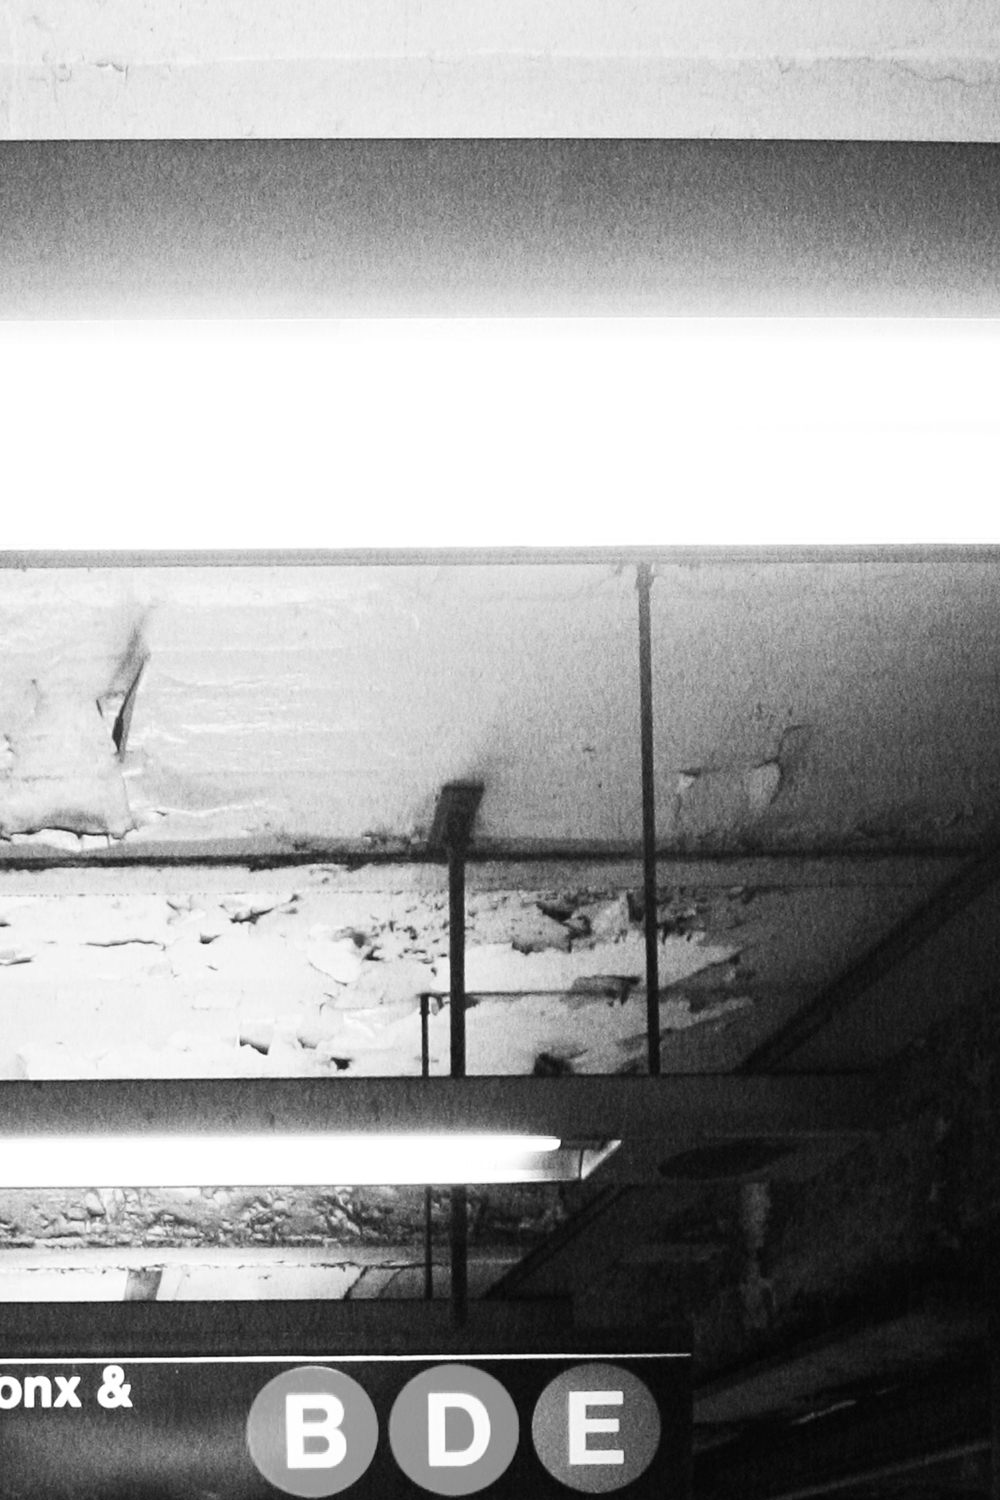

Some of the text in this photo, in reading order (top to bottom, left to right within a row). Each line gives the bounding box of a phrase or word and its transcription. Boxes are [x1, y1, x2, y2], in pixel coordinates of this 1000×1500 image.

[96, 1364, 134, 1409] &
[285, 1391, 624, 1469] B D E
